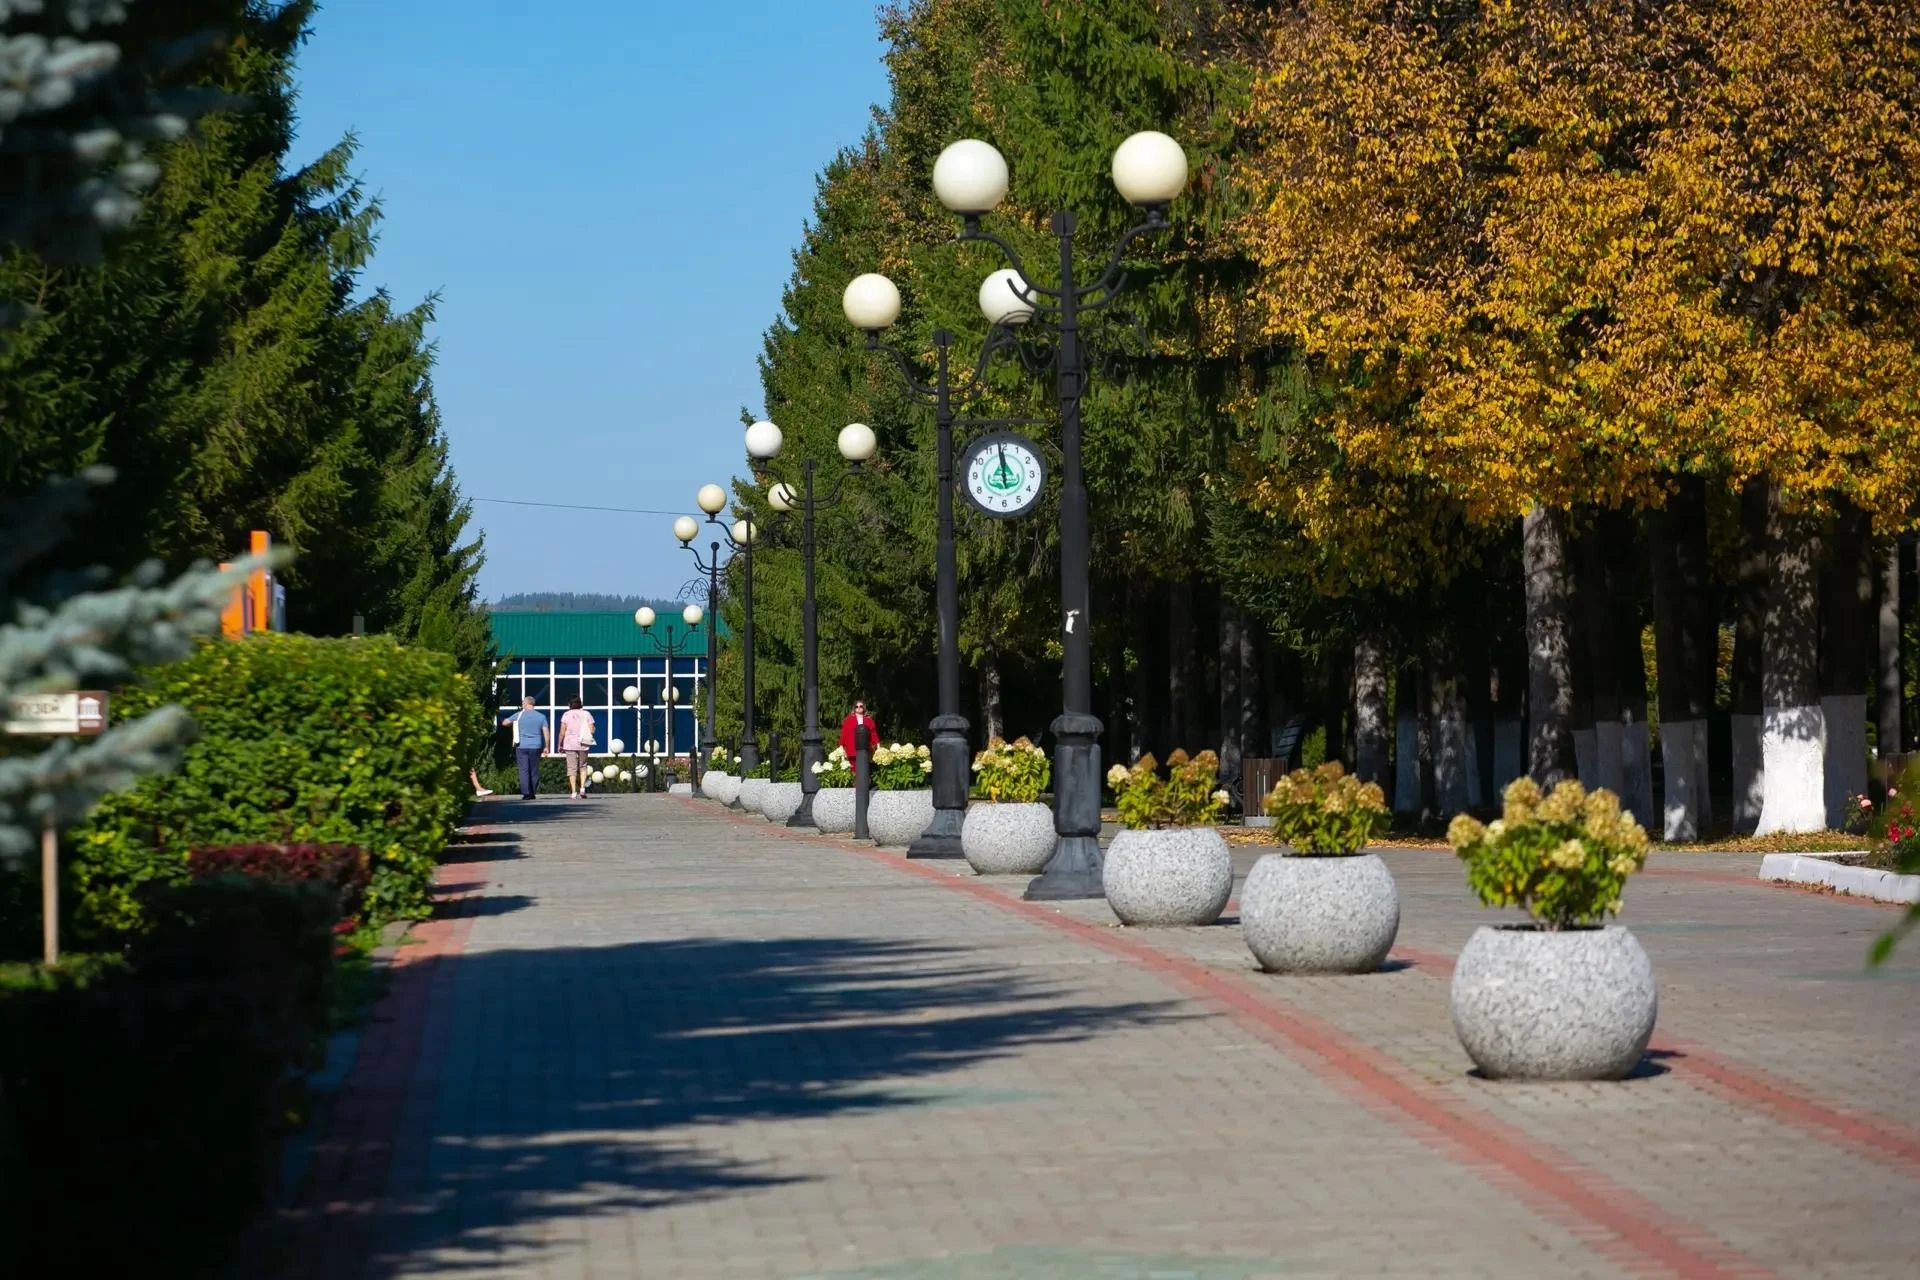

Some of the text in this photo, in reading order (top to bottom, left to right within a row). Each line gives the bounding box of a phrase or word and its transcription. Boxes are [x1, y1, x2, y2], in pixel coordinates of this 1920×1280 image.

[986, 447, 993, 455] 11
[975, 457, 984, 466] 10
[973, 472, 978, 480] 9
[1029, 470, 1035, 478] 3
